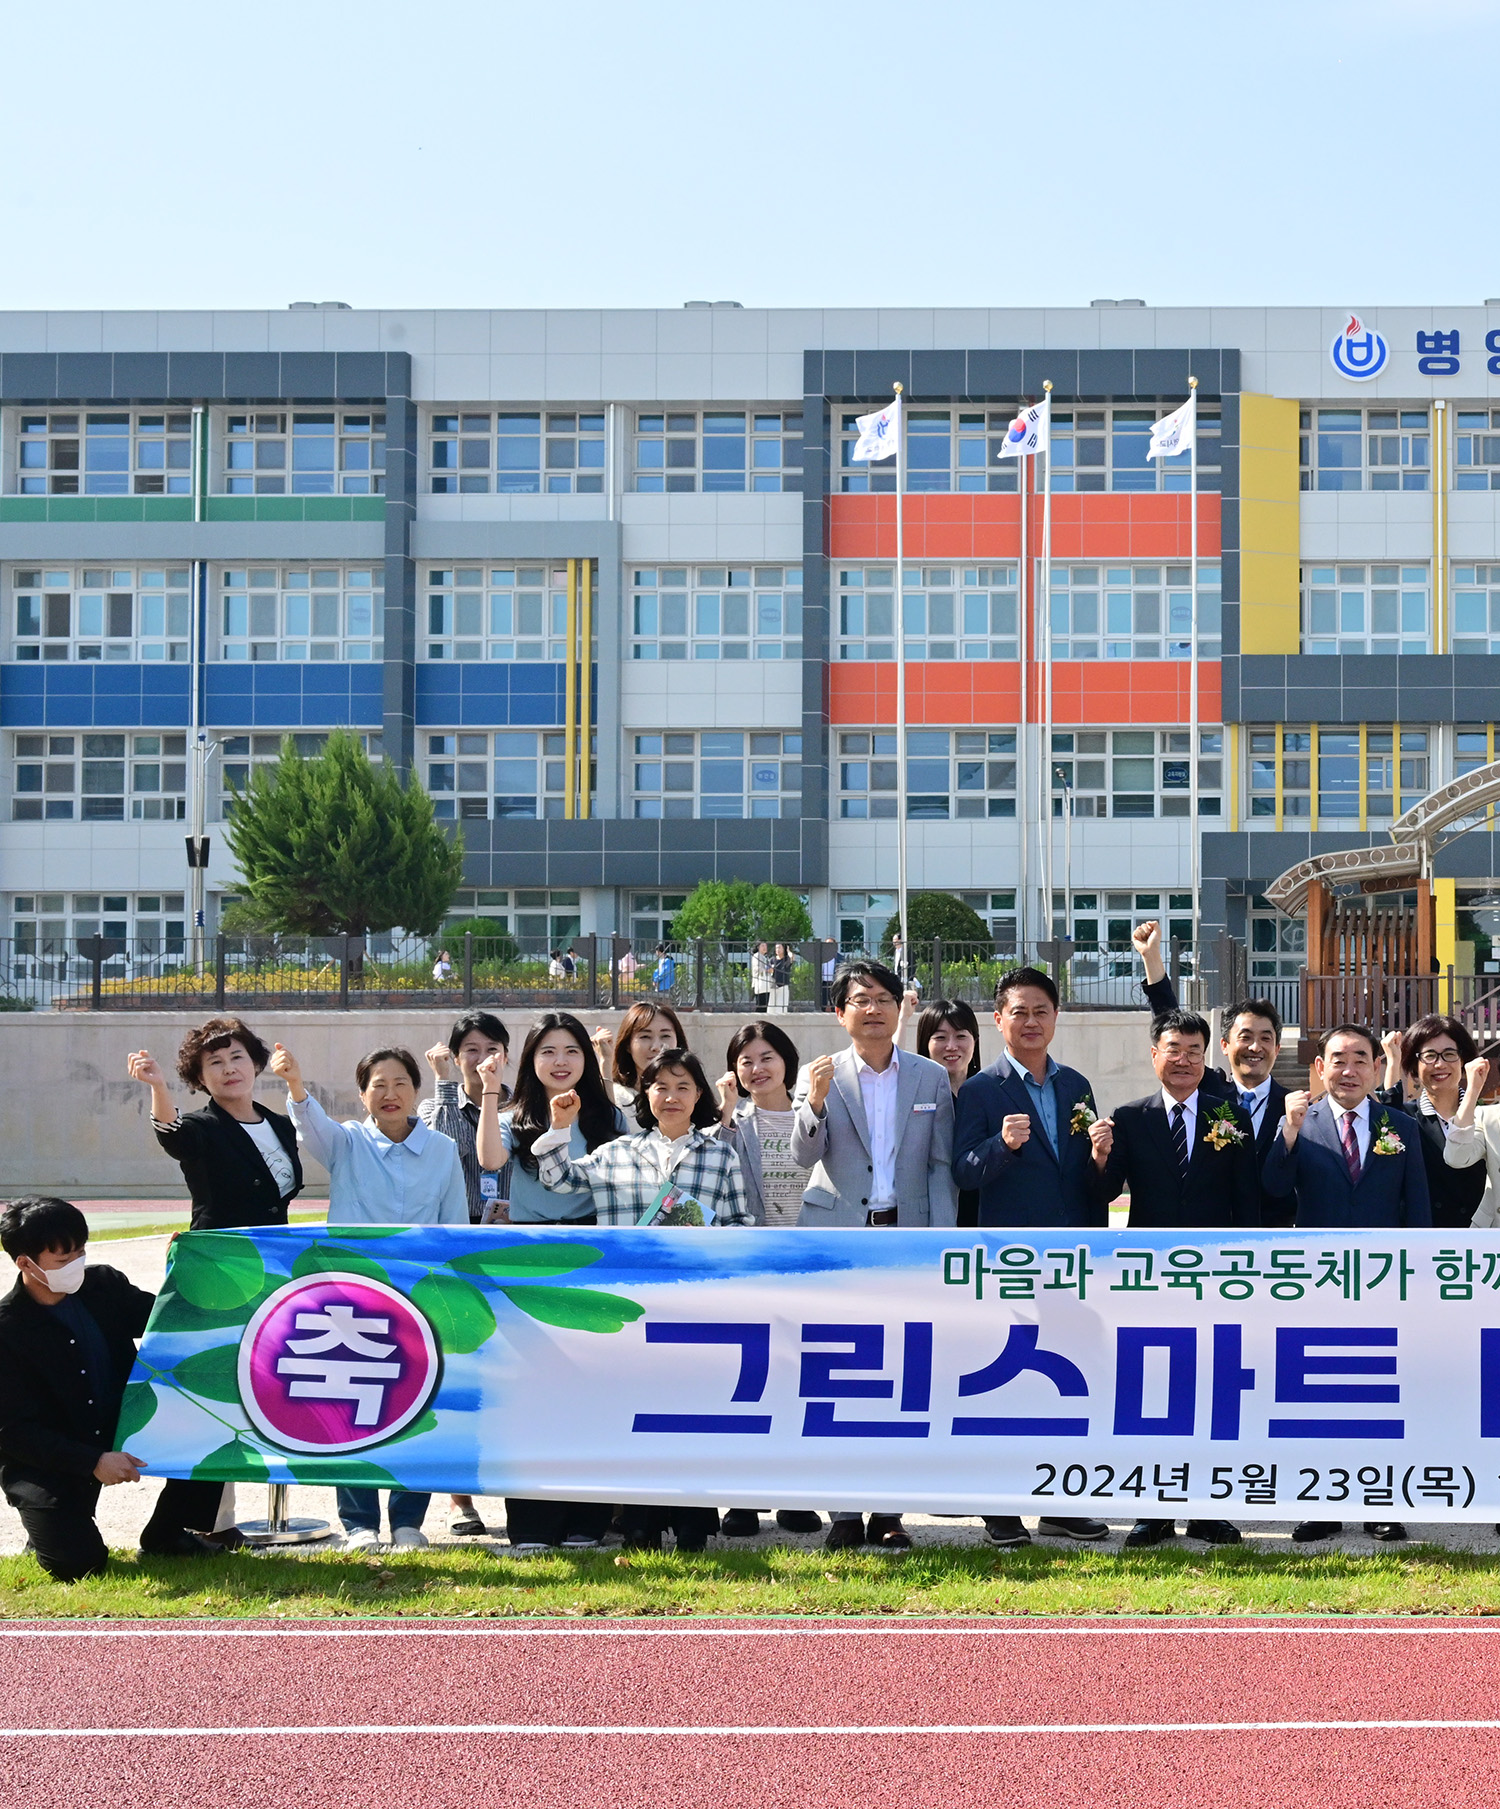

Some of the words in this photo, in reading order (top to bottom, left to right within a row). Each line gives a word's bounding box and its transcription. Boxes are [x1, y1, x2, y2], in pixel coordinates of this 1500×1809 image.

[943, 1247, 1094, 1301] 마을과
[1109, 1248, 1415, 1301] 교육공동체가
[276, 1305, 401, 1425] 축
[631, 1307, 1405, 1441] 그린스마트
[1031, 1462, 1191, 1504] 2024년
[1210, 1463, 1277, 1505] 5월
[1296, 1465, 1476, 1509] 23일(목)
